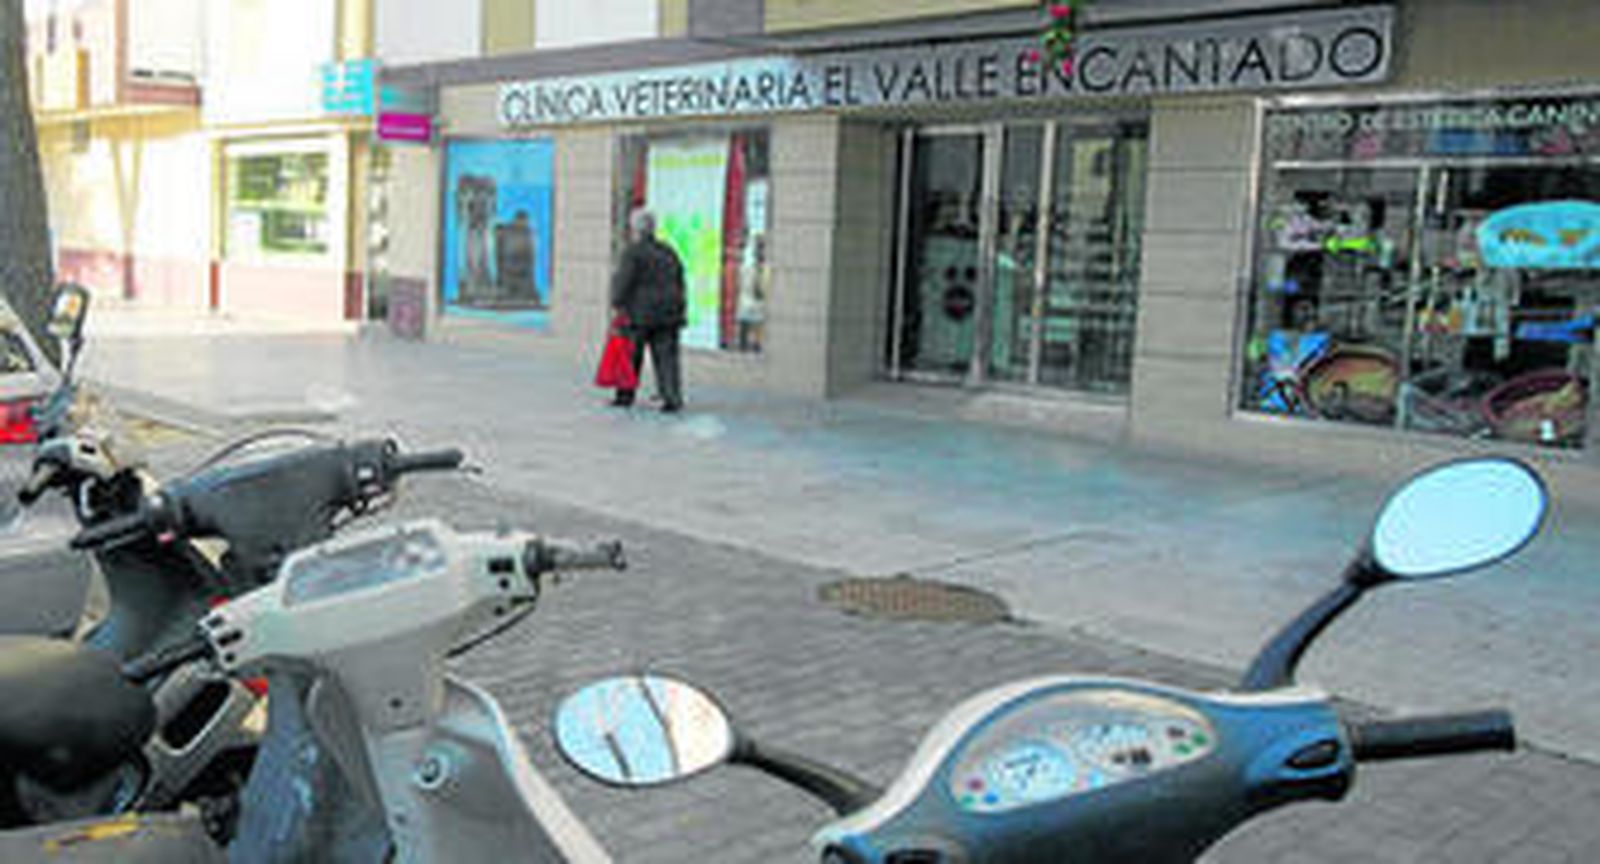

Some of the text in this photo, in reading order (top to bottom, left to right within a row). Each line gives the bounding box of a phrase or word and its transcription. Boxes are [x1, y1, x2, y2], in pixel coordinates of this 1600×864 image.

[614, 67, 811, 115] VETERINARIA
[825, 65, 860, 106] EL
[874, 55, 998, 101] VALLE
[1015, 26, 1383, 96] ENCANTADO
